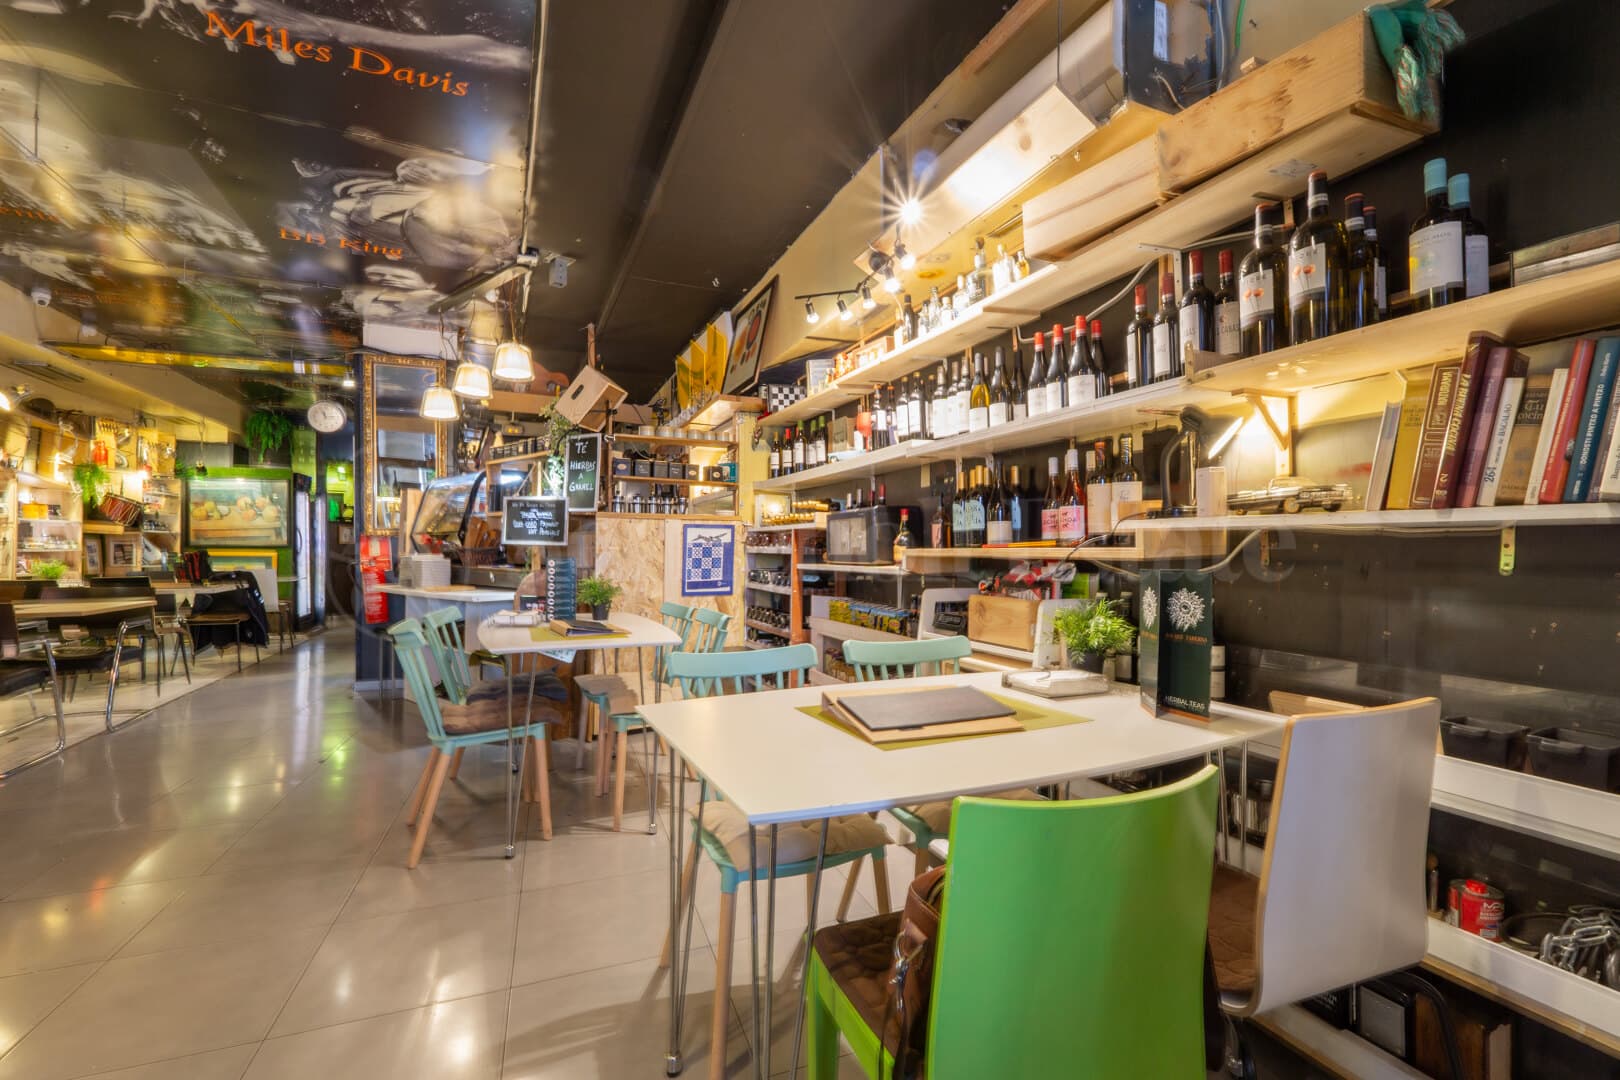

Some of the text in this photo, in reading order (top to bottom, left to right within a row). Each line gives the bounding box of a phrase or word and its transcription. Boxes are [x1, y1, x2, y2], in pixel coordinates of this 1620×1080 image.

[204, 11, 470, 97] Miles Davis
[339, 236, 403, 260] King
[1498, 403, 1513, 437] BACALAO
[1190, 699, 1206, 711] TEAS
